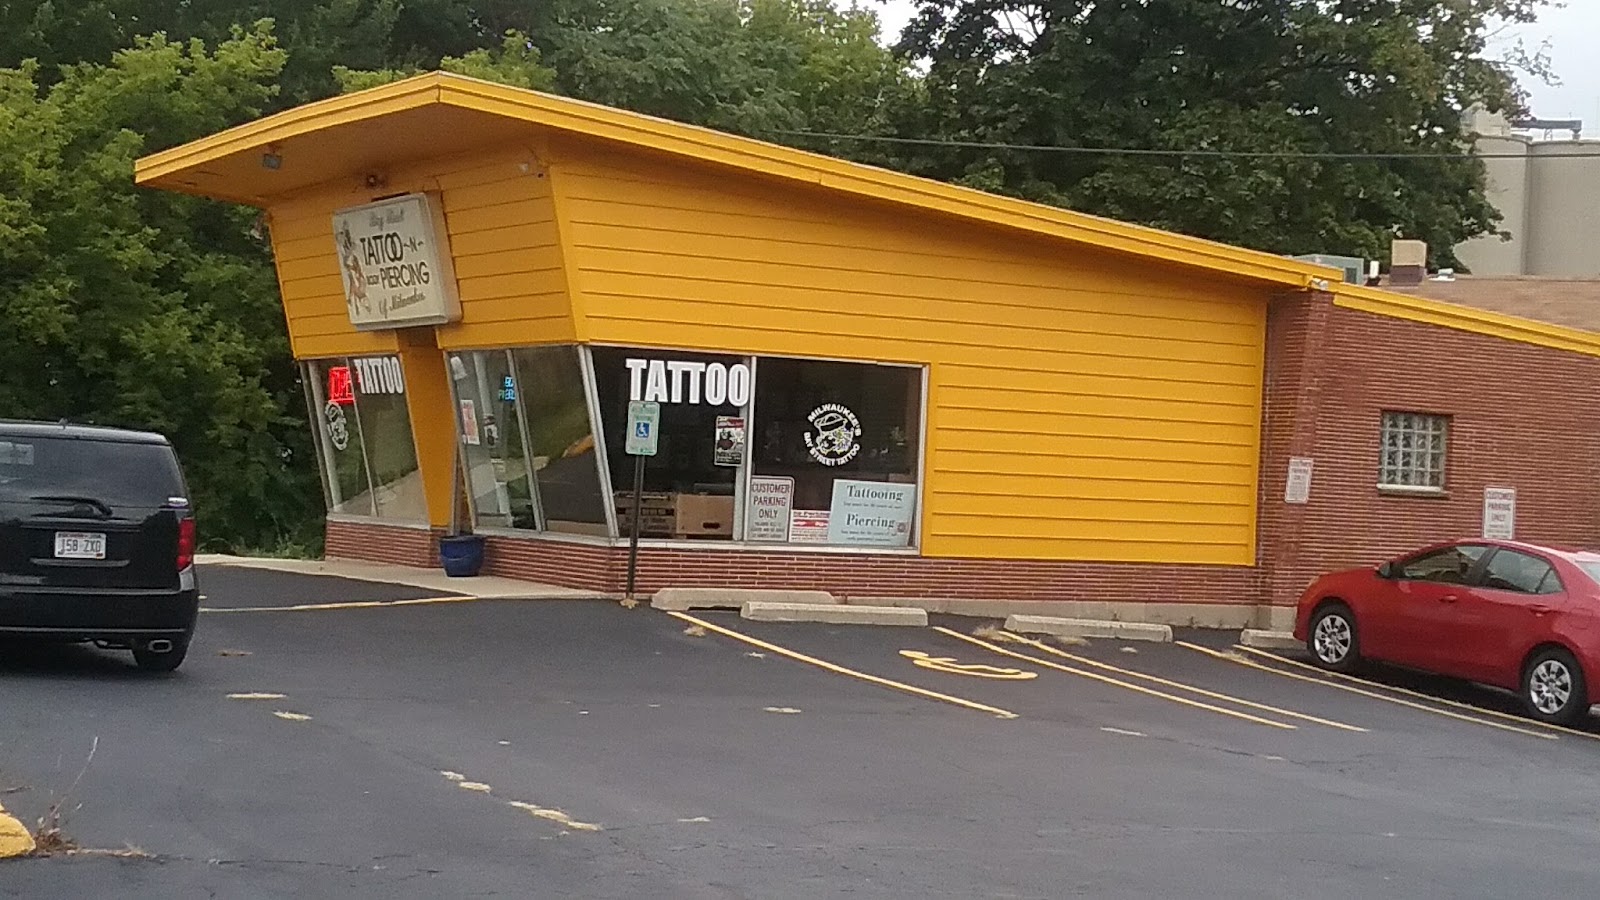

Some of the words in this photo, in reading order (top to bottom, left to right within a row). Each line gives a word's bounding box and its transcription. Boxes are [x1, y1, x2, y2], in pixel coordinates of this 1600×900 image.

[360, 232, 404, 266] TATTOO
[380, 261, 430, 290] PIERCING
[353, 356, 404, 394] TATTOO
[625, 358, 750, 407] TATTOO
[803, 431, 814, 448] BAY
[809, 447, 836, 467] STREET
[835, 443, 861, 466] TATTOO
[751, 483, 790, 494] CUSTOMER
[846, 485, 904, 502] Tattooing
[753, 495, 787, 507] PARKING
[758, 508, 778, 519] ONLY
[846, 513, 896, 530] Piercing
